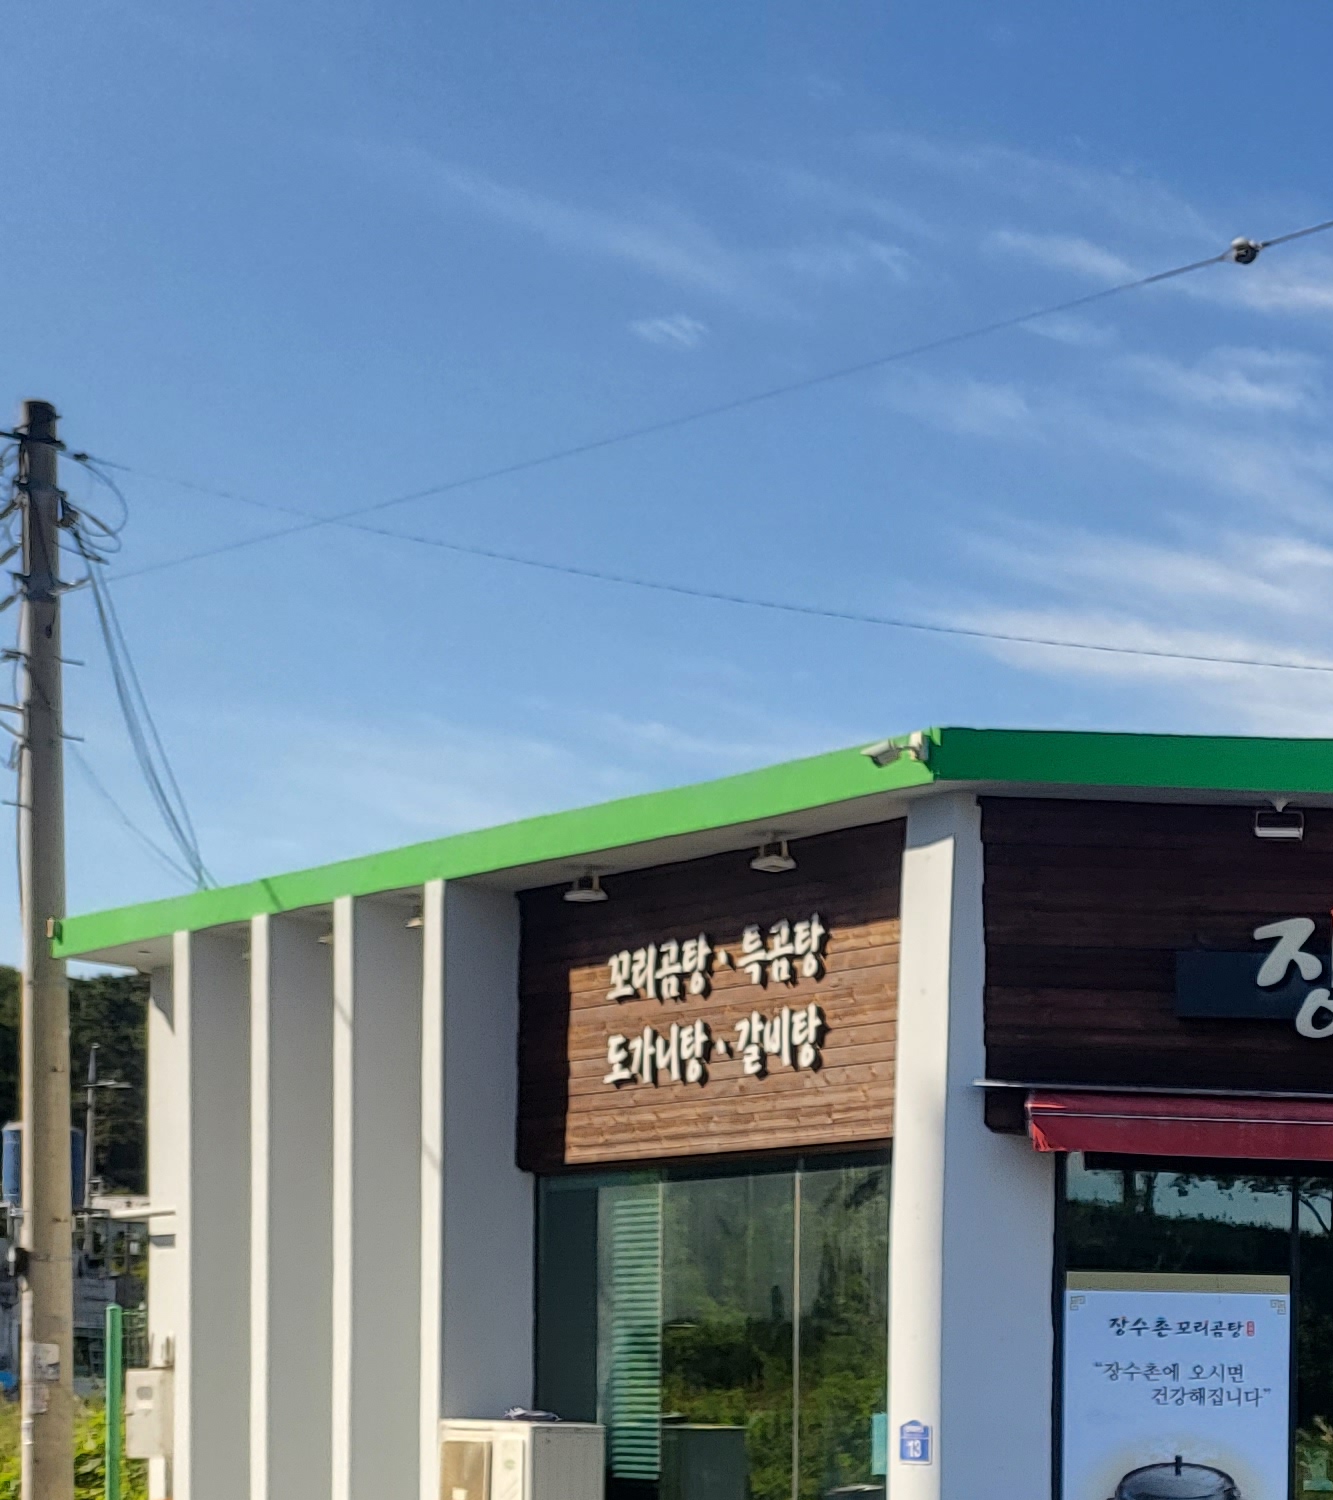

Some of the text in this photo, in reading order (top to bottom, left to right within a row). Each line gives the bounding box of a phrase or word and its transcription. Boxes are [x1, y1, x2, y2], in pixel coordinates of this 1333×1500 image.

[607, 913, 826, 1001] 꼬리곰탕 특곰탕
[603, 1003, 822, 1086] 도가니탕 갈비탕
[1108, 1316, 1173, 1338] 장수촌
[1175, 1319, 1244, 1339] 꼬리곰탕
[1188, 1363, 1246, 1384] 오시면
[905, 1439, 922, 1458] 13
